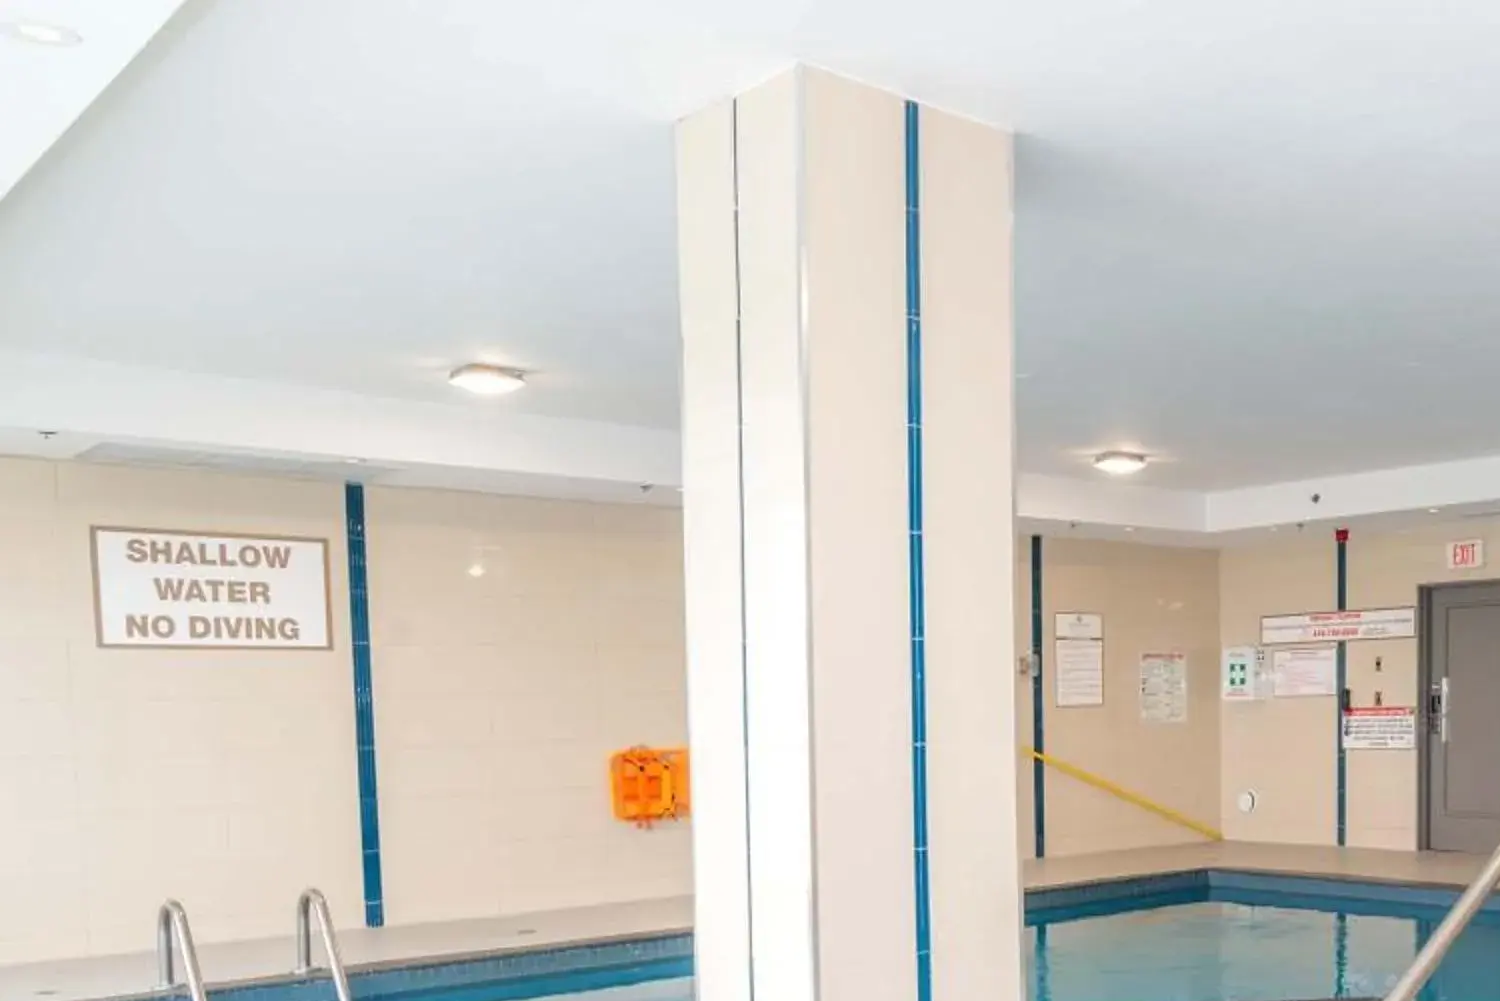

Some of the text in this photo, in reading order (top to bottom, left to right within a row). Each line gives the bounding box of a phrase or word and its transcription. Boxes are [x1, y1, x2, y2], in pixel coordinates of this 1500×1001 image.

[126, 539, 291, 569] SHALLOW
[1453, 543, 1475, 566] EXIT
[153, 577, 271, 605] WATER
[125, 614, 300, 640] NO DIVING
